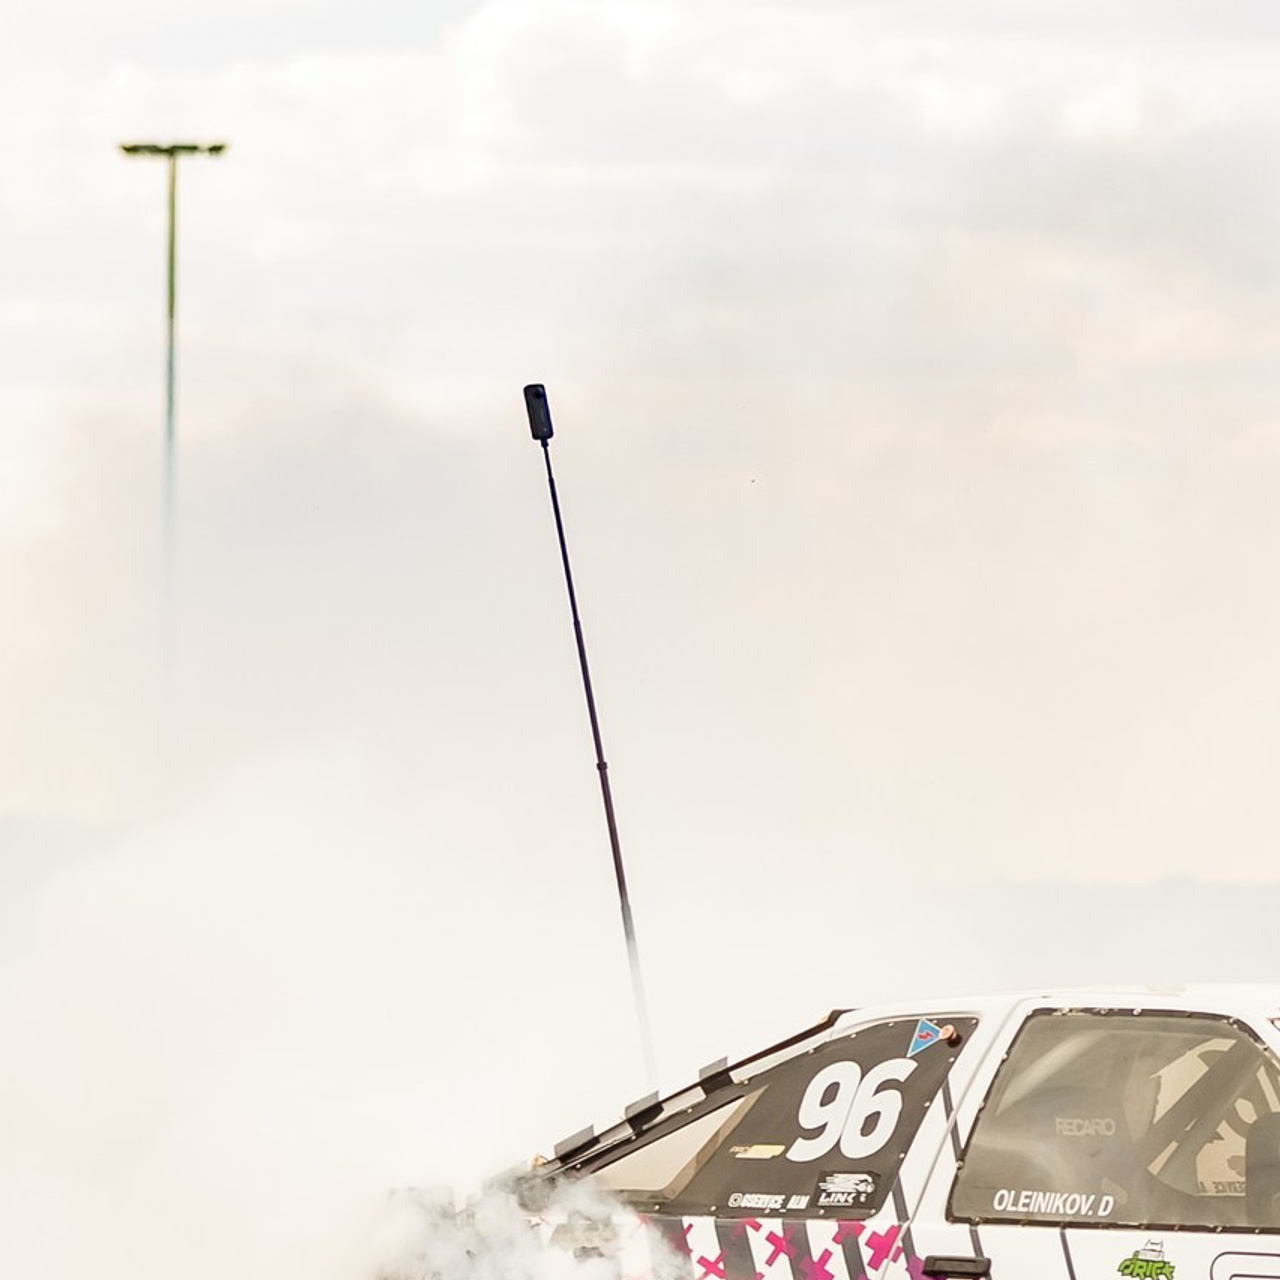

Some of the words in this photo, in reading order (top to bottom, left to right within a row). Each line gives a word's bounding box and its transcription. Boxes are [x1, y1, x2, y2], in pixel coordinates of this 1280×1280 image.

[785, 1058, 918, 1162] 96
[1055, 1117, 1116, 1136] RECARO
[993, 1188, 1095, 1216] OLEINIKOV.
[1097, 1195, 1115, 1217] D
